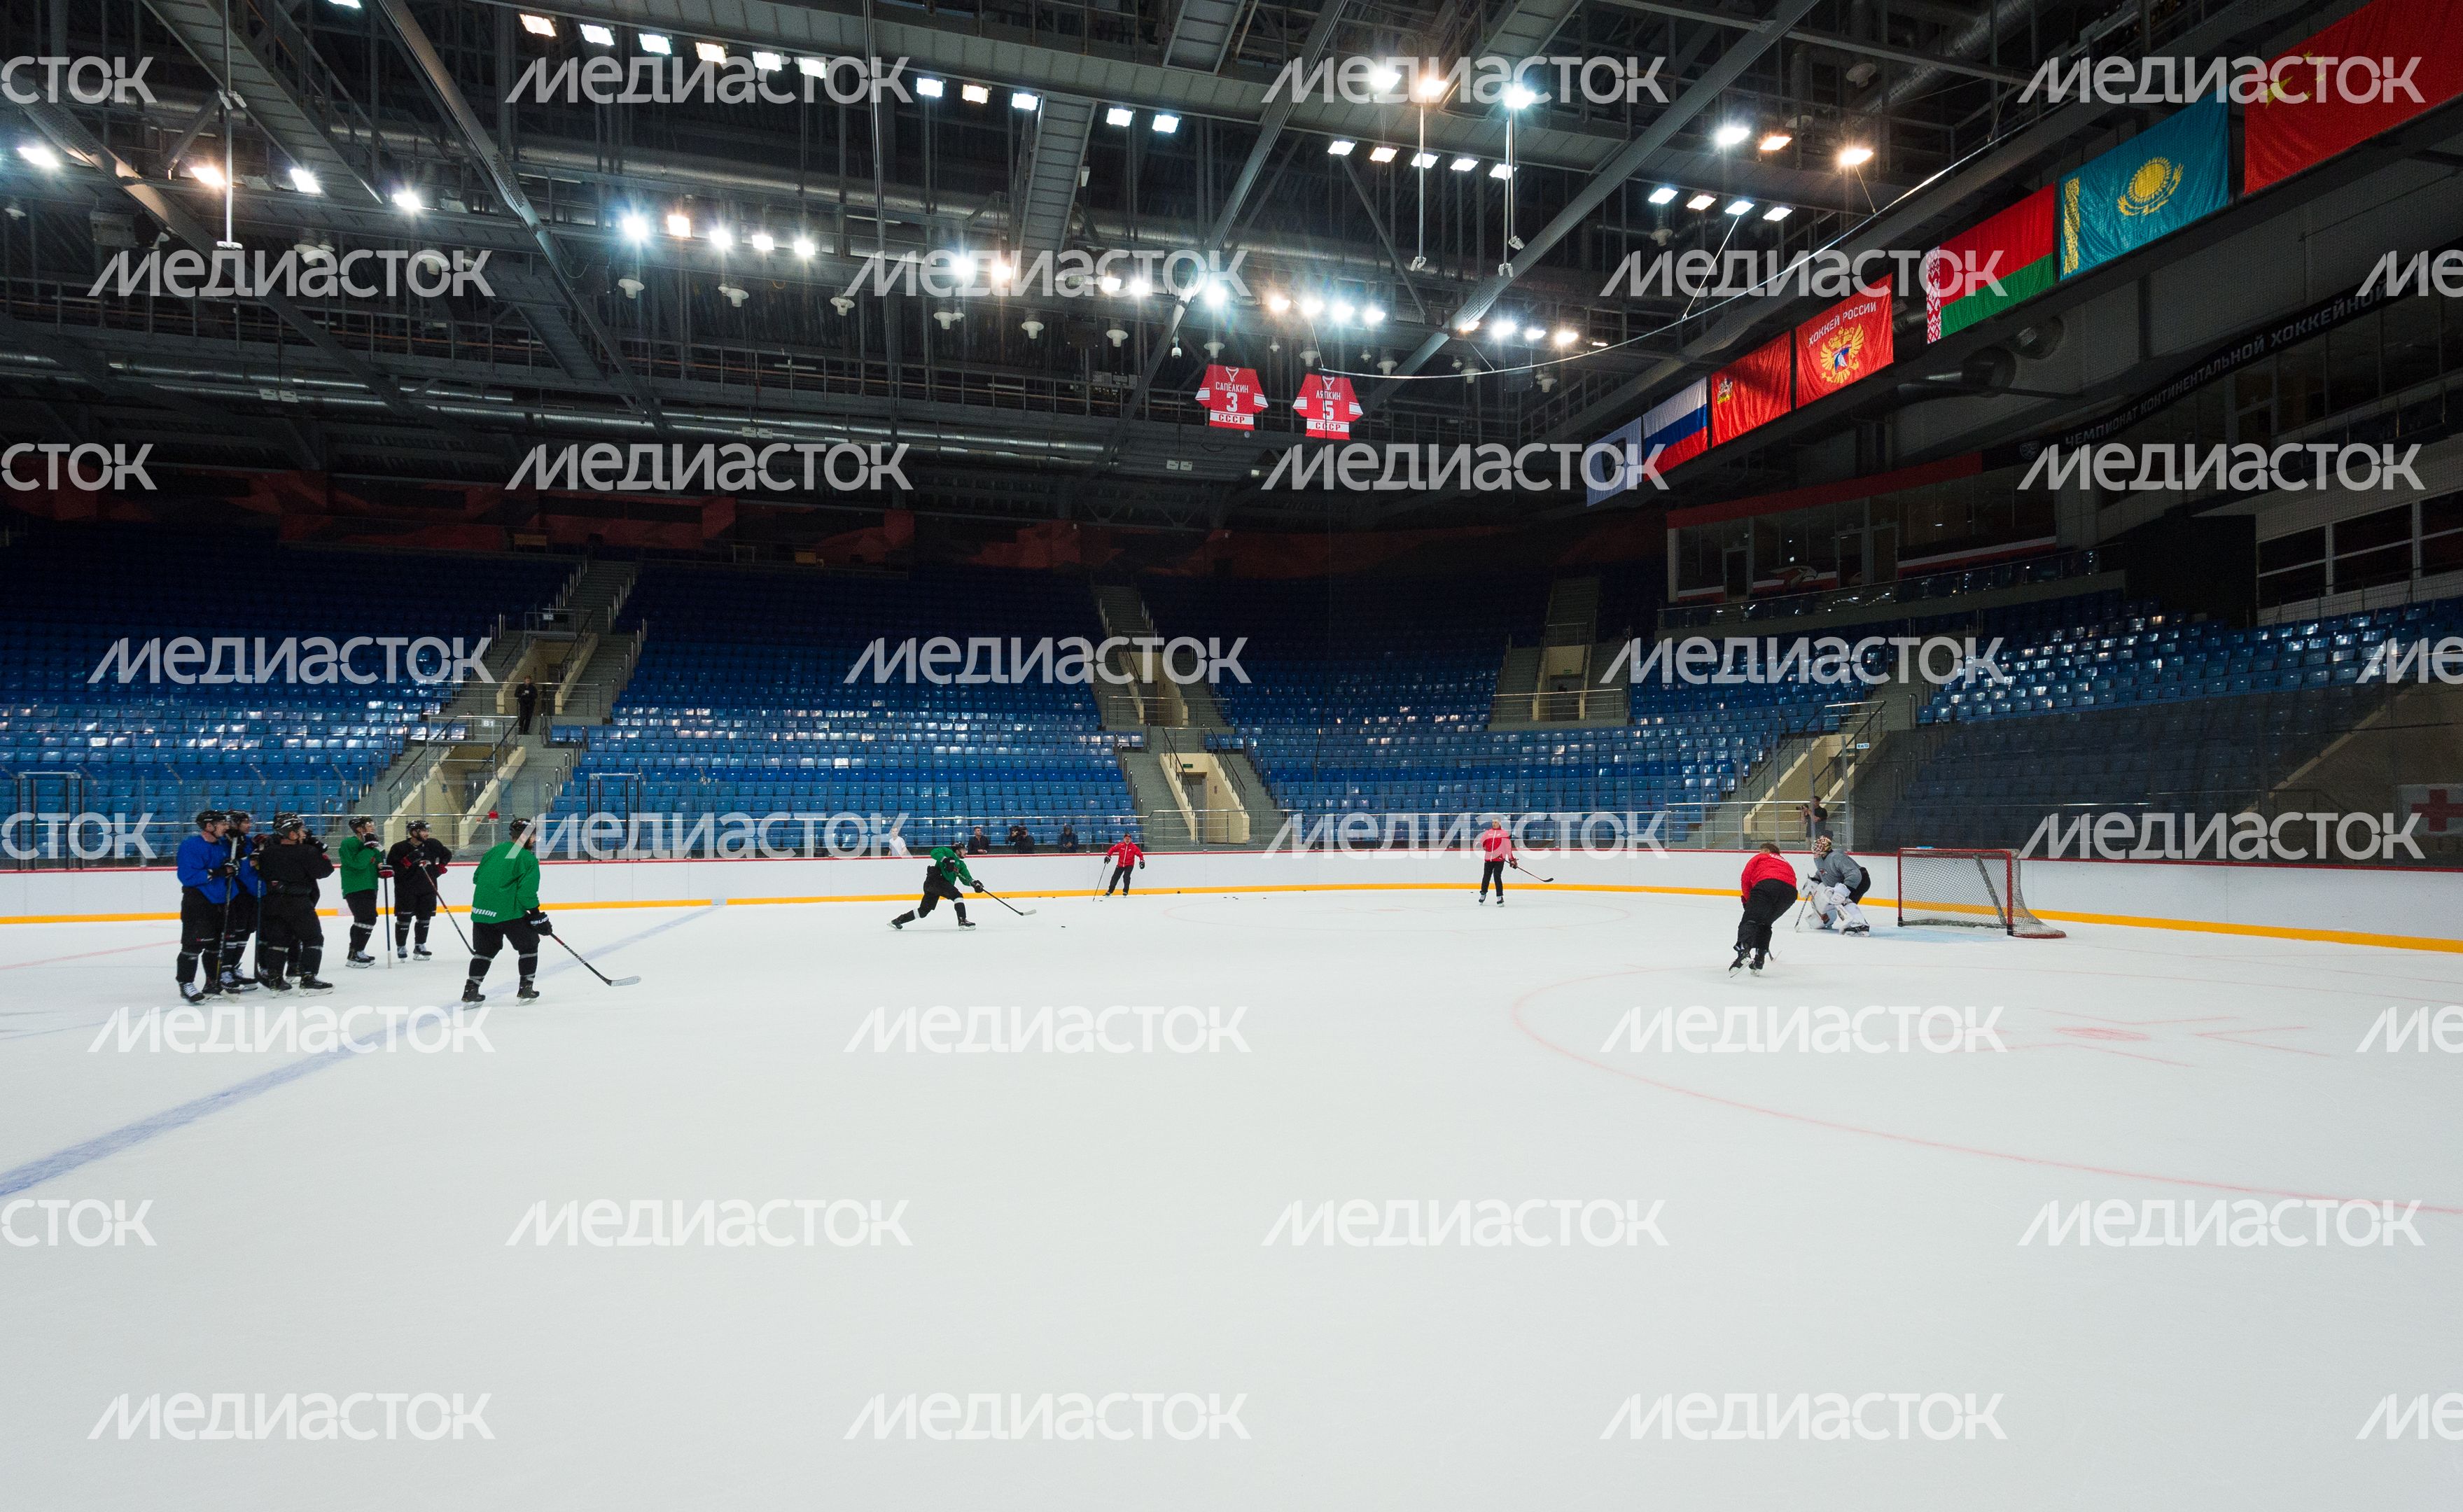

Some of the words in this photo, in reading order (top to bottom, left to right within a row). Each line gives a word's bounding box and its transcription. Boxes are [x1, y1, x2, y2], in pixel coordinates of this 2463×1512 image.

[1808, 314, 1840, 347] ХОККЕЙ
[1843, 301, 1876, 323] РОССИИ
[1215, 382, 1249, 393] САПЁЛКИН
[2065, 407, 2137, 447] ЧЕМПИОНАТ
[2140, 336, 2266, 414] КОНТИНЕНТАЛЬНОЙ
[1226, 392, 1238, 412] 3
[1316, 390, 1341, 401] ЛЯПКИН
[1323, 400, 1334, 421] 5
[1218, 414, 1245, 424] СССР
[1316, 422, 1341, 431] СССР
